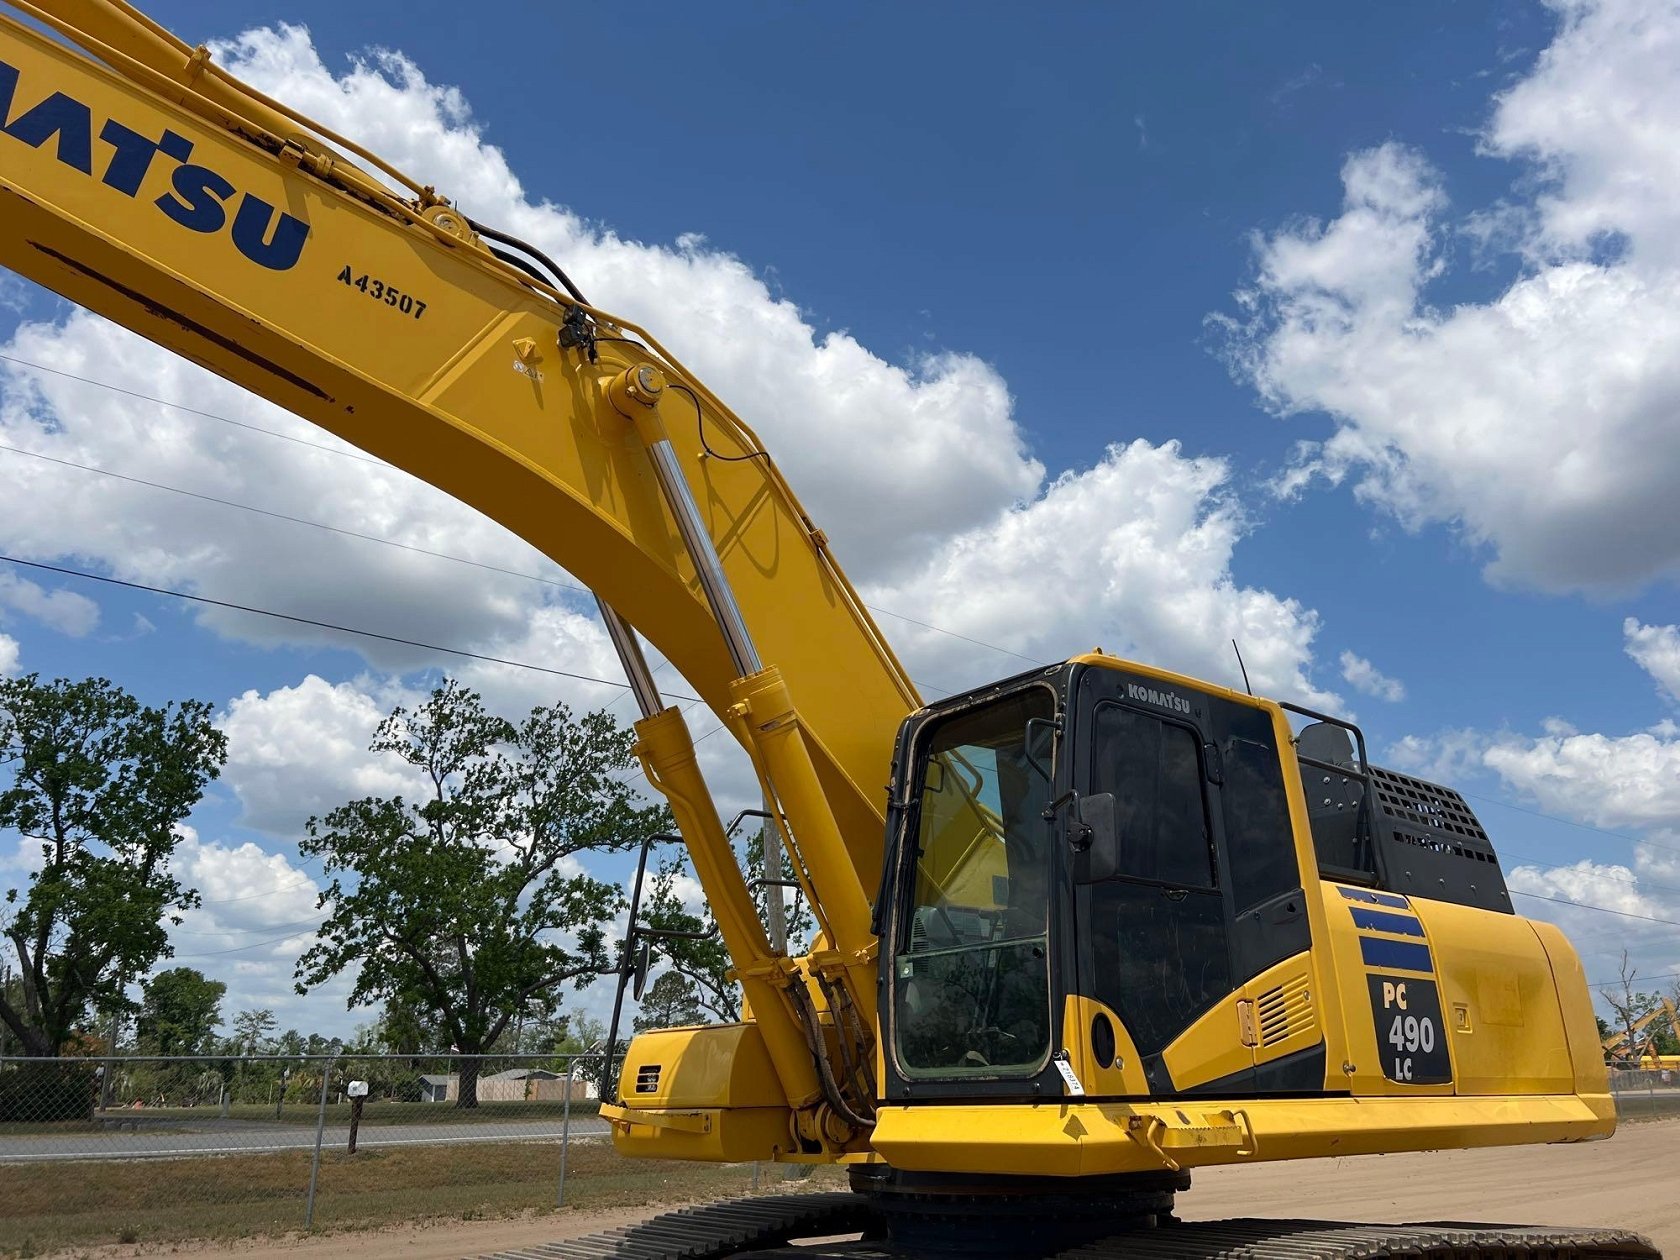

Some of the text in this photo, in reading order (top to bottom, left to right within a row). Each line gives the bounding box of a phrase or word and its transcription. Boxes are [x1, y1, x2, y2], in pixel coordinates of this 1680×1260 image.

[0, 60, 310, 270] ATSU
[337, 265, 427, 319] A43507
[1128, 683, 1190, 714] KOMATSU
[1383, 981, 1407, 1010] PC
[1389, 1015, 1435, 1053] 490
[1395, 1058, 1412, 1080] LC
